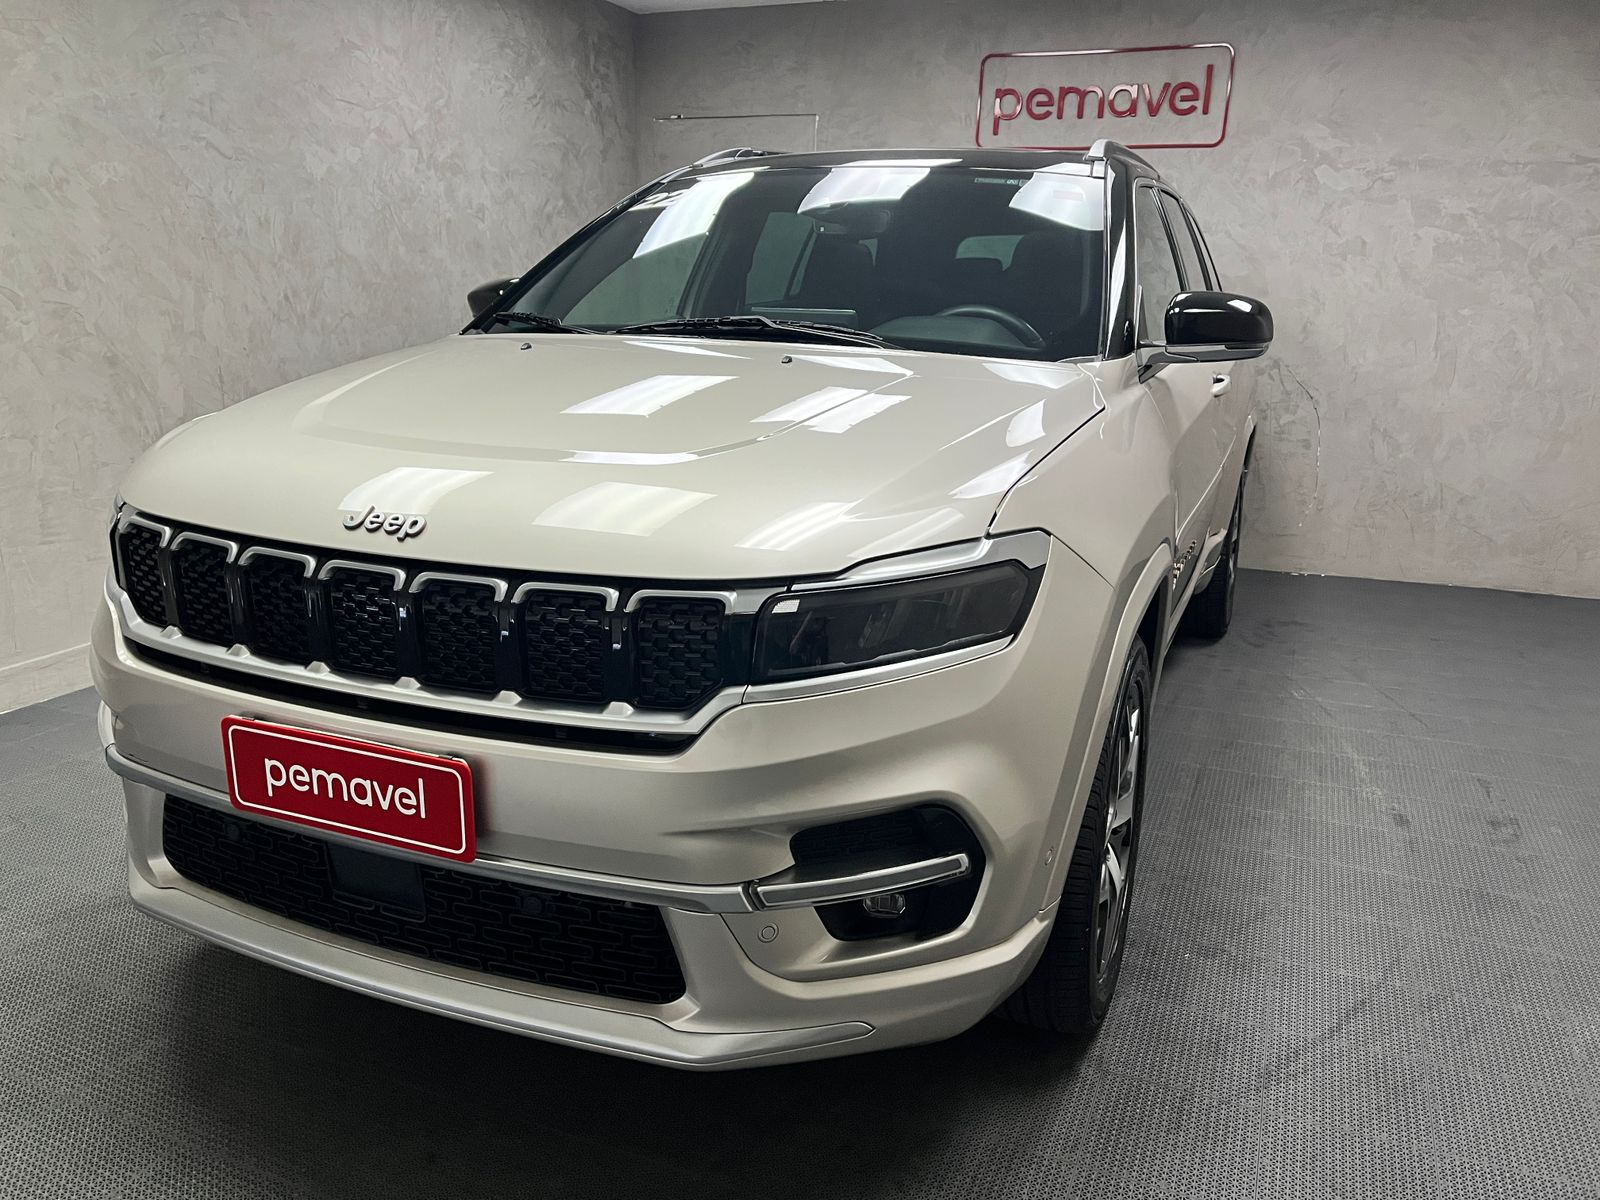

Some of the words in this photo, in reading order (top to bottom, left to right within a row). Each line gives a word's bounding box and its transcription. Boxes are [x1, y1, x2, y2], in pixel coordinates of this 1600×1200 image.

[992, 64, 1214, 136] pemavel
[342, 505, 427, 542] Jeep
[264, 758, 426, 819] pemavel
